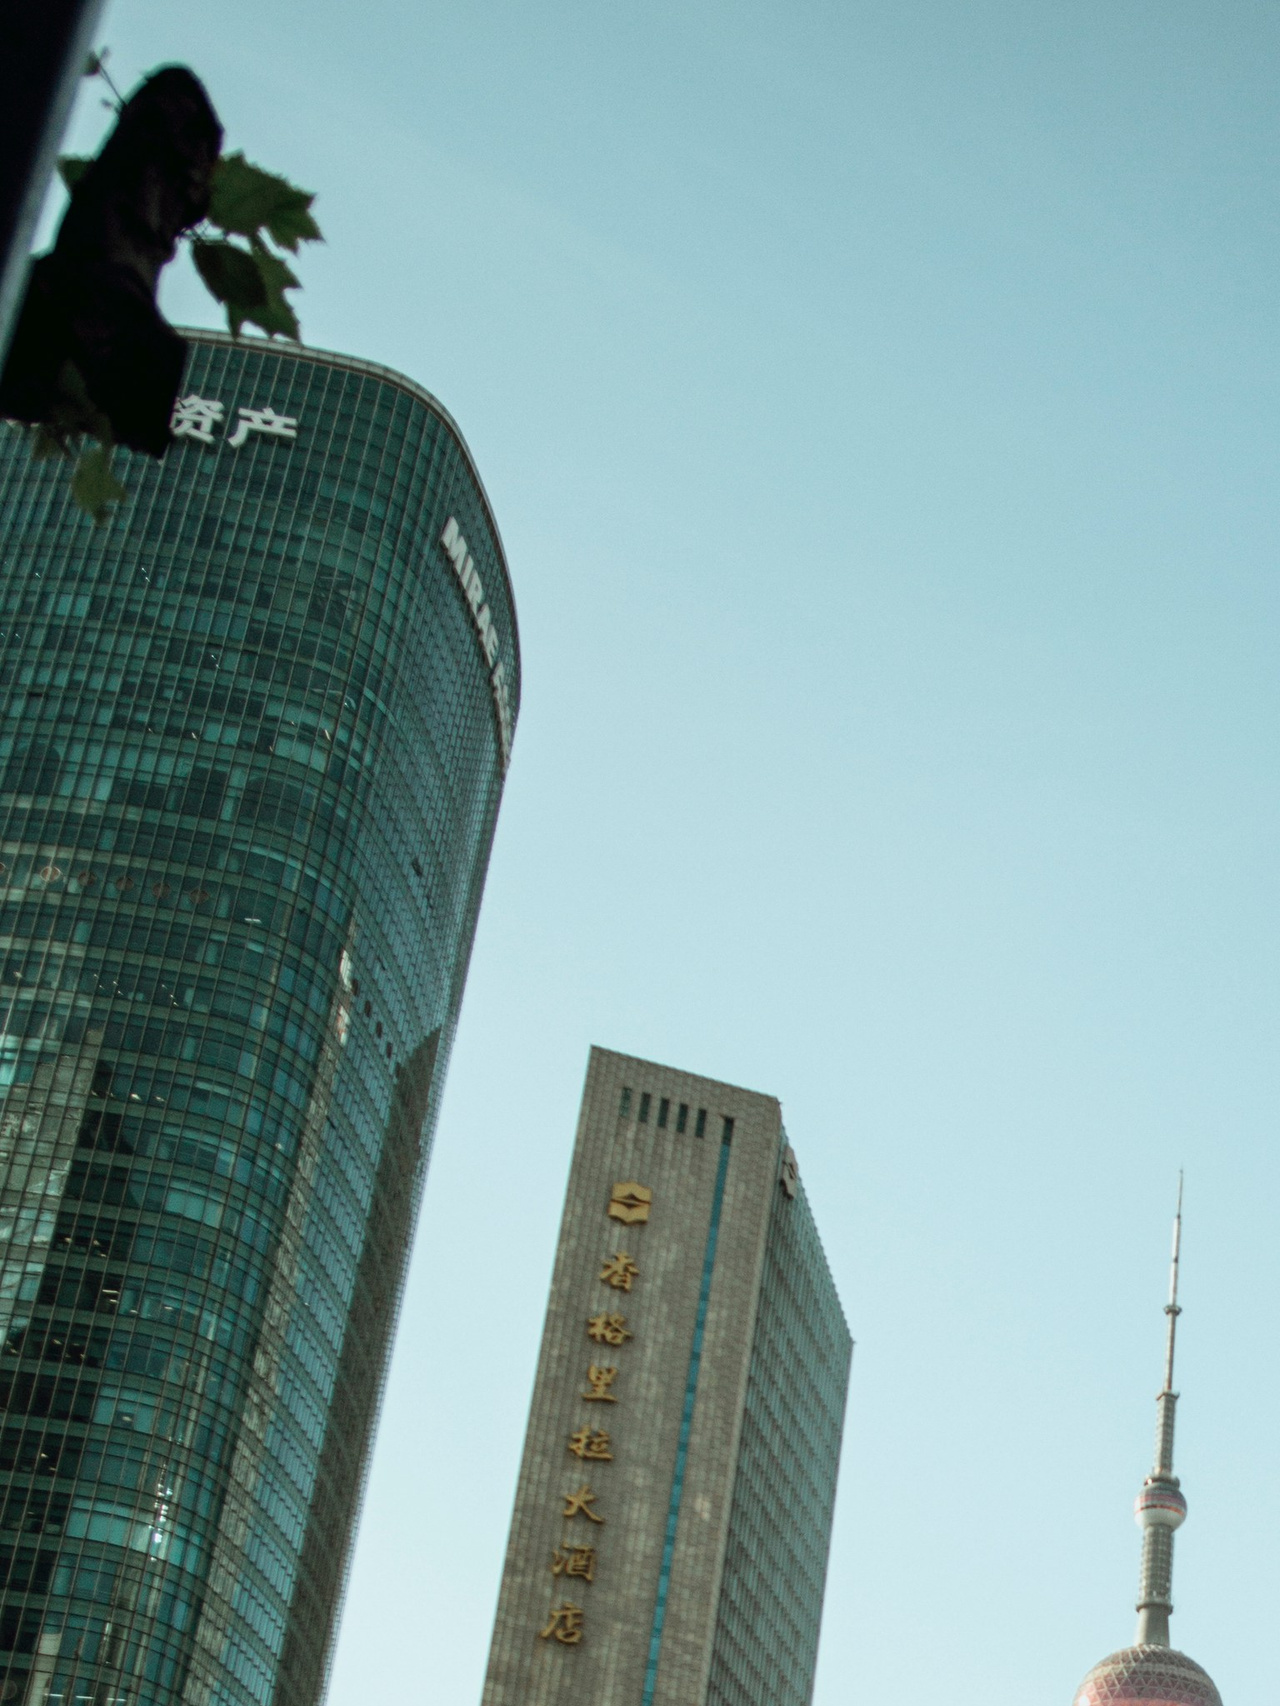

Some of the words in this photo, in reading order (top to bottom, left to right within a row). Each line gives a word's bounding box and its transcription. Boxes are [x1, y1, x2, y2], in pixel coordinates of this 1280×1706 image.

[440, 515, 499, 669] MIRAE
[540, 1250, 640, 1646] 香格里拉大酒店
